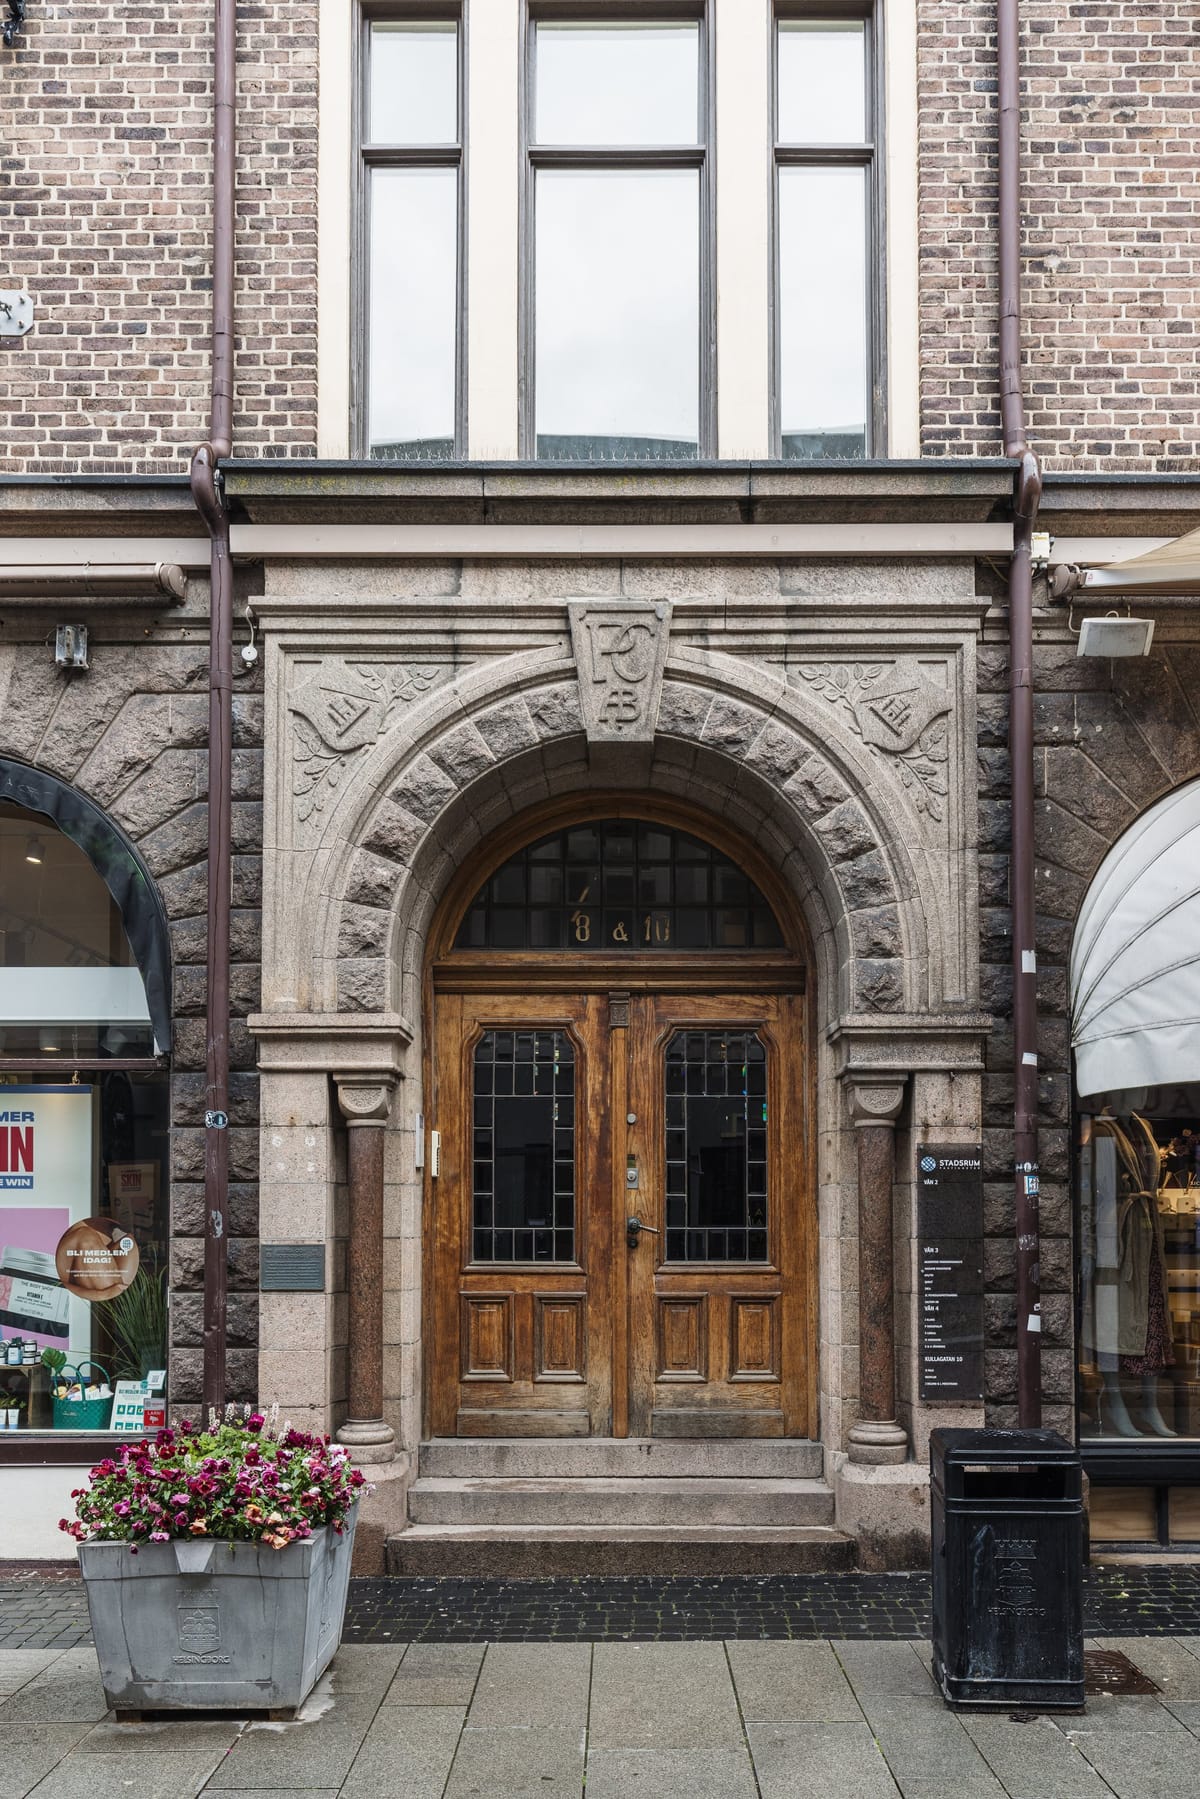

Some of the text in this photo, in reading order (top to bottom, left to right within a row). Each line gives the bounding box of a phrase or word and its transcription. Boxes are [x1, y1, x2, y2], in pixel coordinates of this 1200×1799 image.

[612, 921, 629, 941] &
[939, 1159, 981, 1167] STADSRUM
[5, 1178, 31, 1187] WIN
